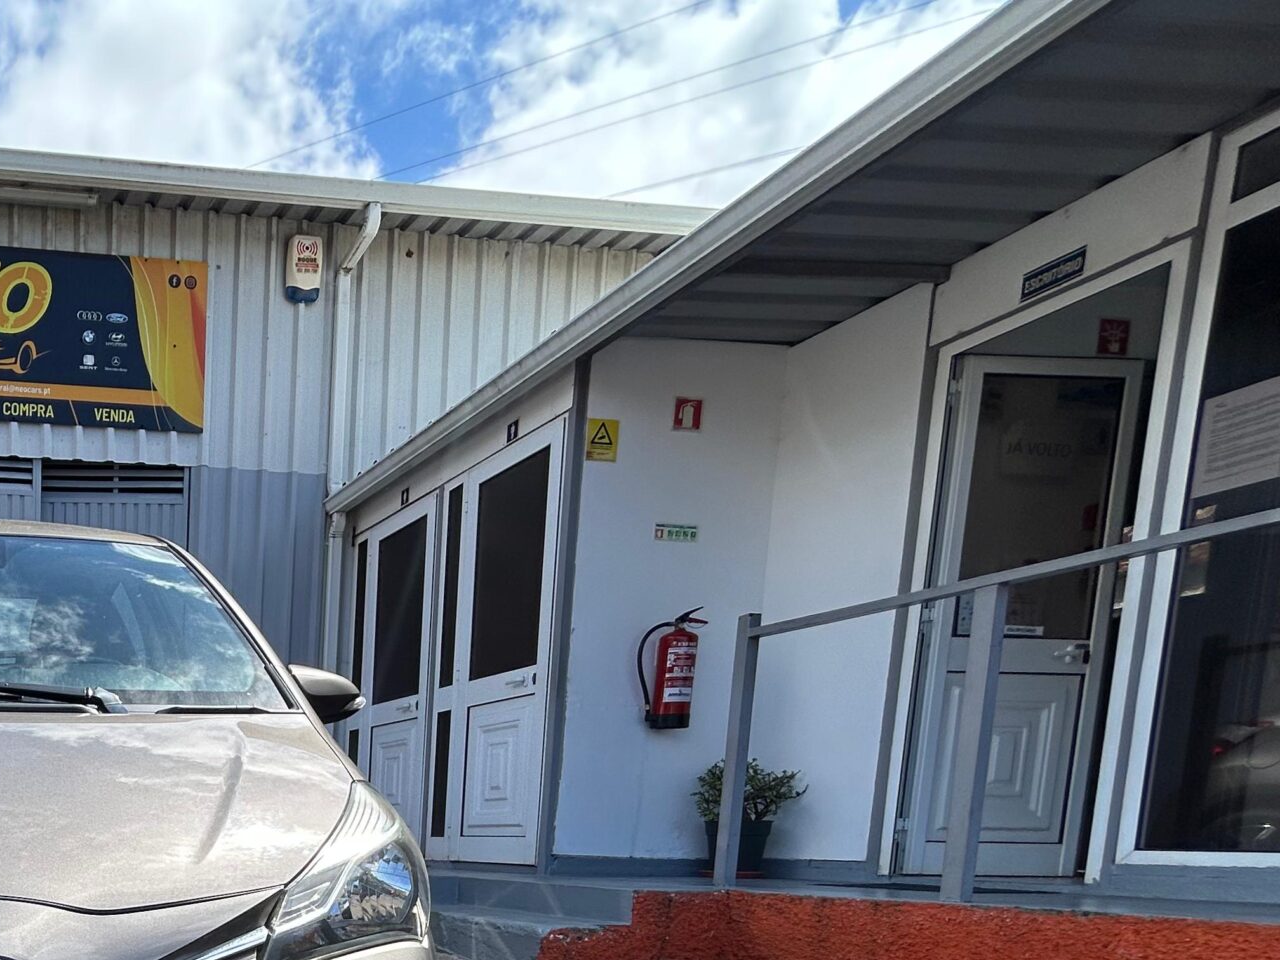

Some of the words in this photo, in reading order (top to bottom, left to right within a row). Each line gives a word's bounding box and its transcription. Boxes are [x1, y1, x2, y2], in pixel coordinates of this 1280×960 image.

[2, 401, 54, 419] COMPRA
[94, 407, 135, 424] VENDA
[1026, 441, 1073, 458] VOLTO
